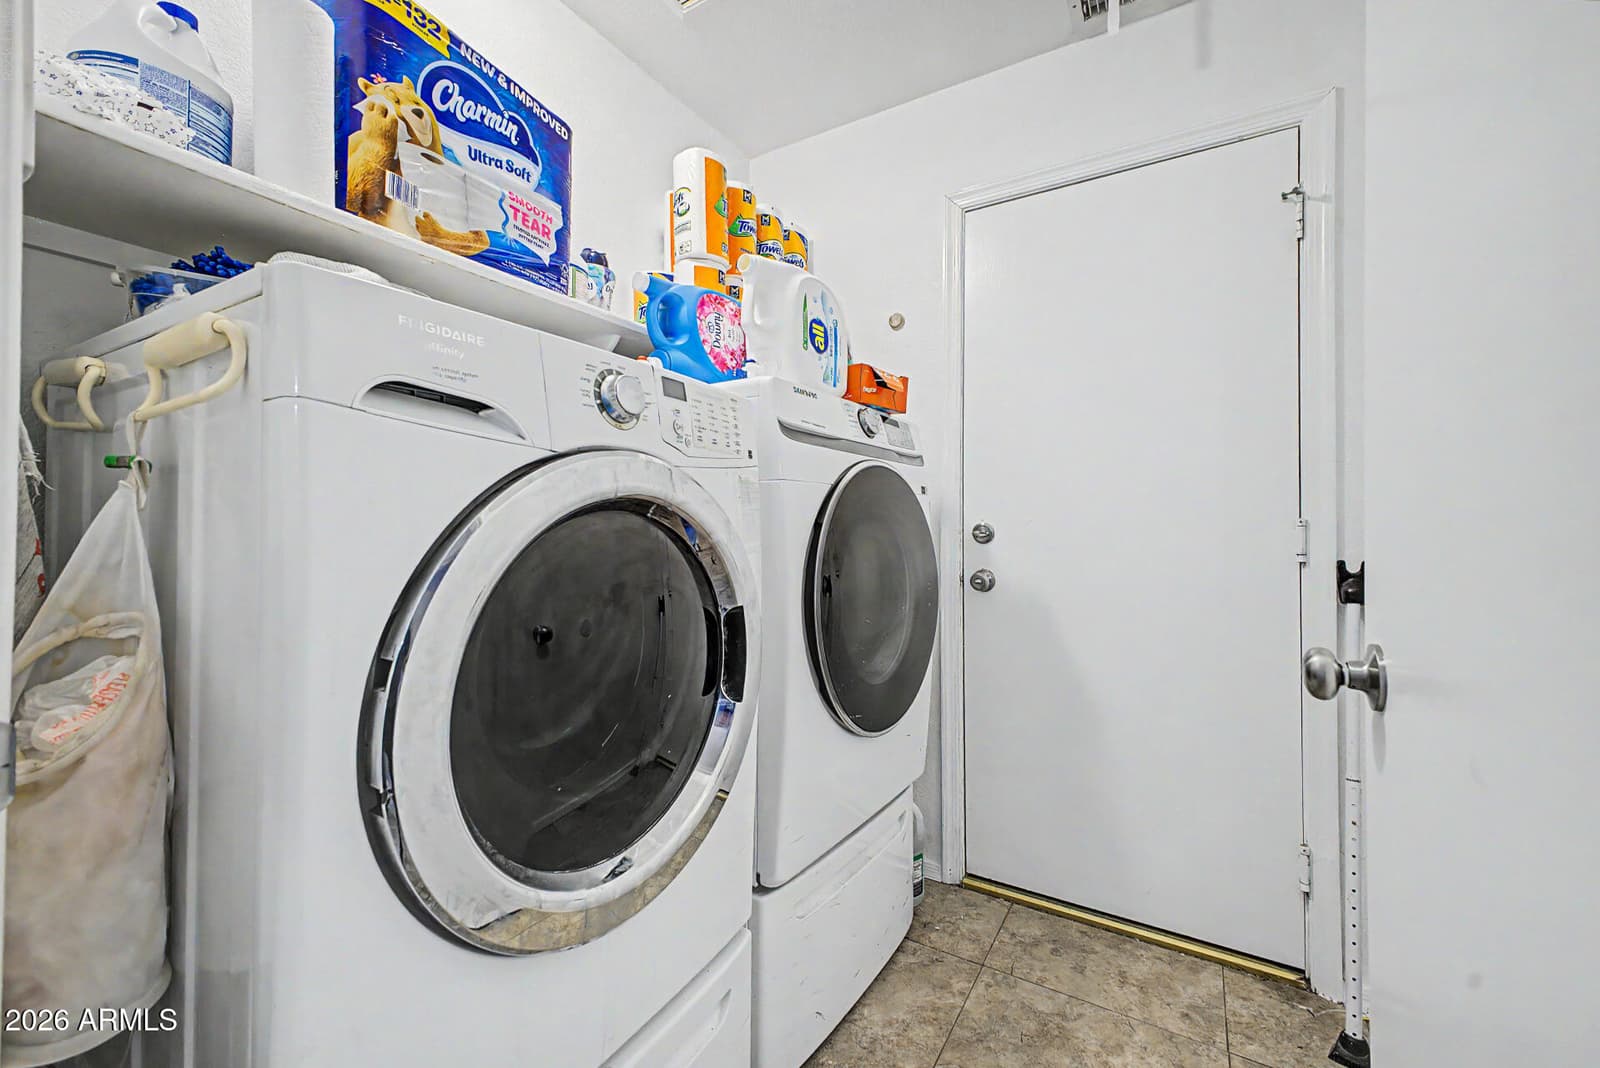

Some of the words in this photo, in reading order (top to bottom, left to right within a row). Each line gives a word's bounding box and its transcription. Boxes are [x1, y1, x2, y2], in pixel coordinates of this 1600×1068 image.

[459, 43, 496, 79] NEW
[498, 72, 508, 90] &
[510, 82, 568, 141] IMPROVED
[432, 79, 520, 146] Charmin
[467, 145, 503, 170] Ultra
[505, 159, 532, 184] Soft
[508, 191, 553, 225] SMOOTH
[509, 204, 551, 240] TEAR
[398, 314, 486, 347] FIGIDAIRE
[713, 312, 724, 349] Downy
[811, 322, 825, 351] all
